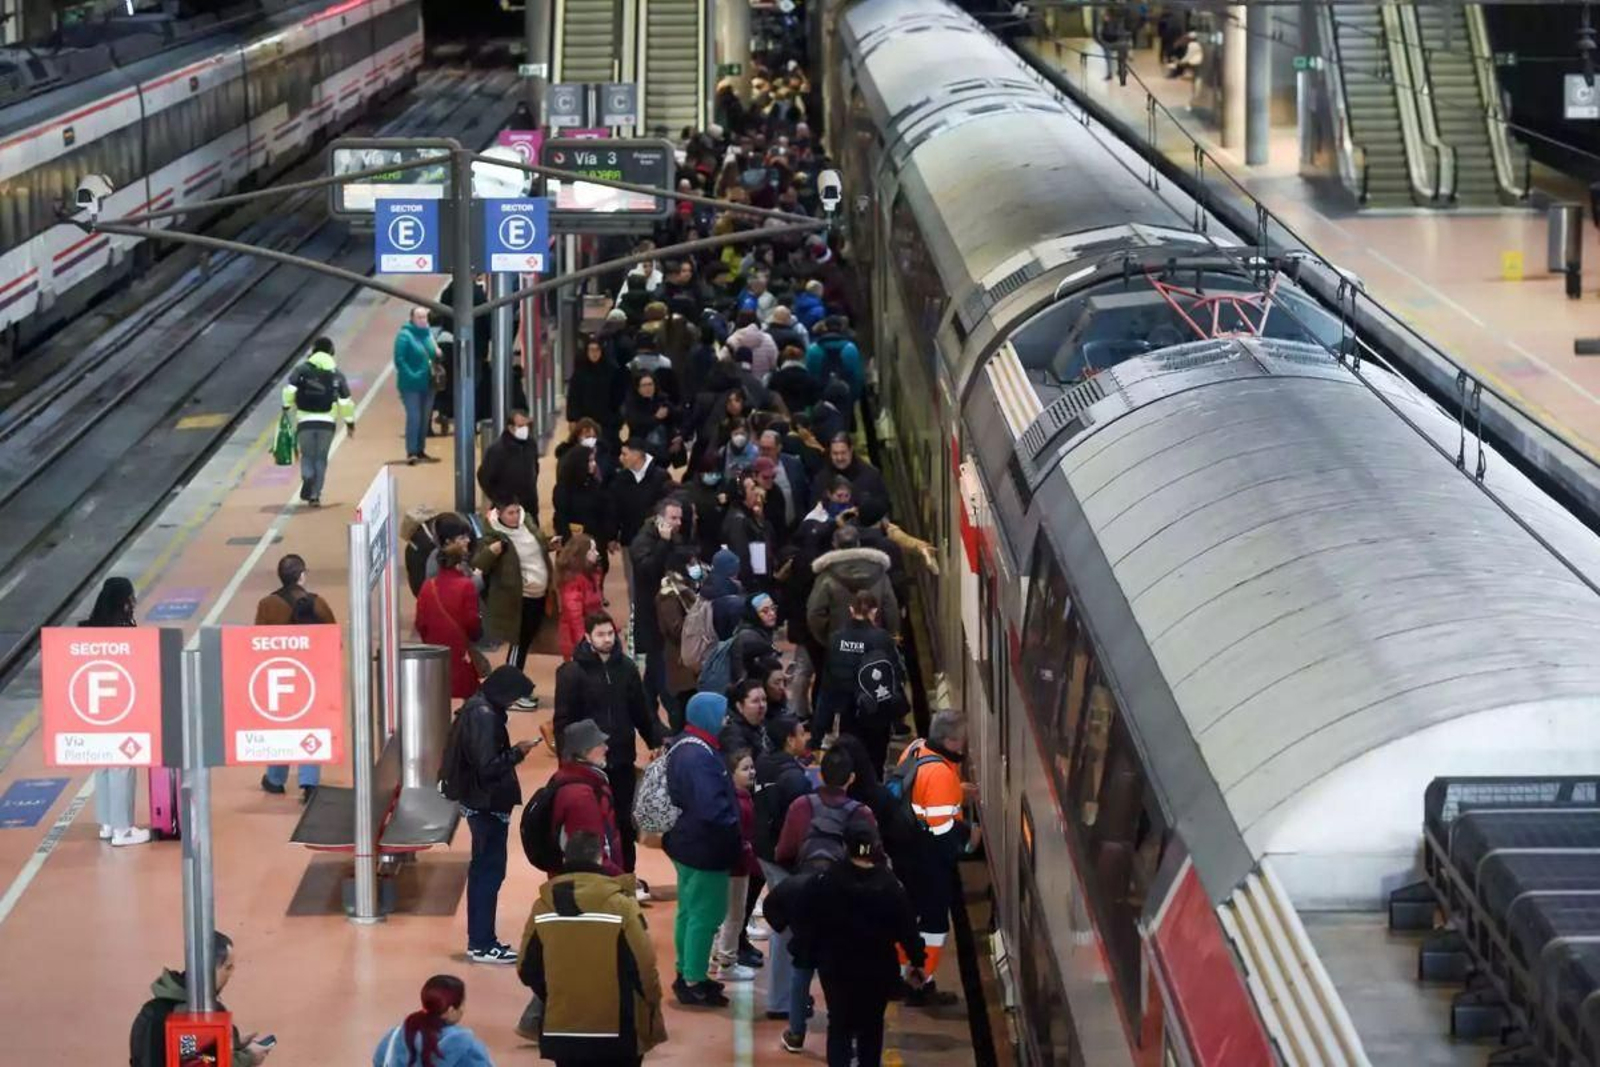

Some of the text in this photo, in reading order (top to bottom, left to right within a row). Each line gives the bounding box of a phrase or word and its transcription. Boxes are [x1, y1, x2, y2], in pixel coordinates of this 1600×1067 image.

[607, 152, 617, 165] 3
[390, 204, 423, 212] SECTOR
[501, 204, 534, 212] SECTOR
[398, 220, 415, 245] E
[509, 220, 525, 245] E
[69, 642, 131, 655] SECTOR
[251, 636, 310, 650] SECTOR
[88, 671, 119, 714] F
[267, 668, 296, 711] F
[124, 740, 136, 755] 4
[305, 736, 317, 751] 3
